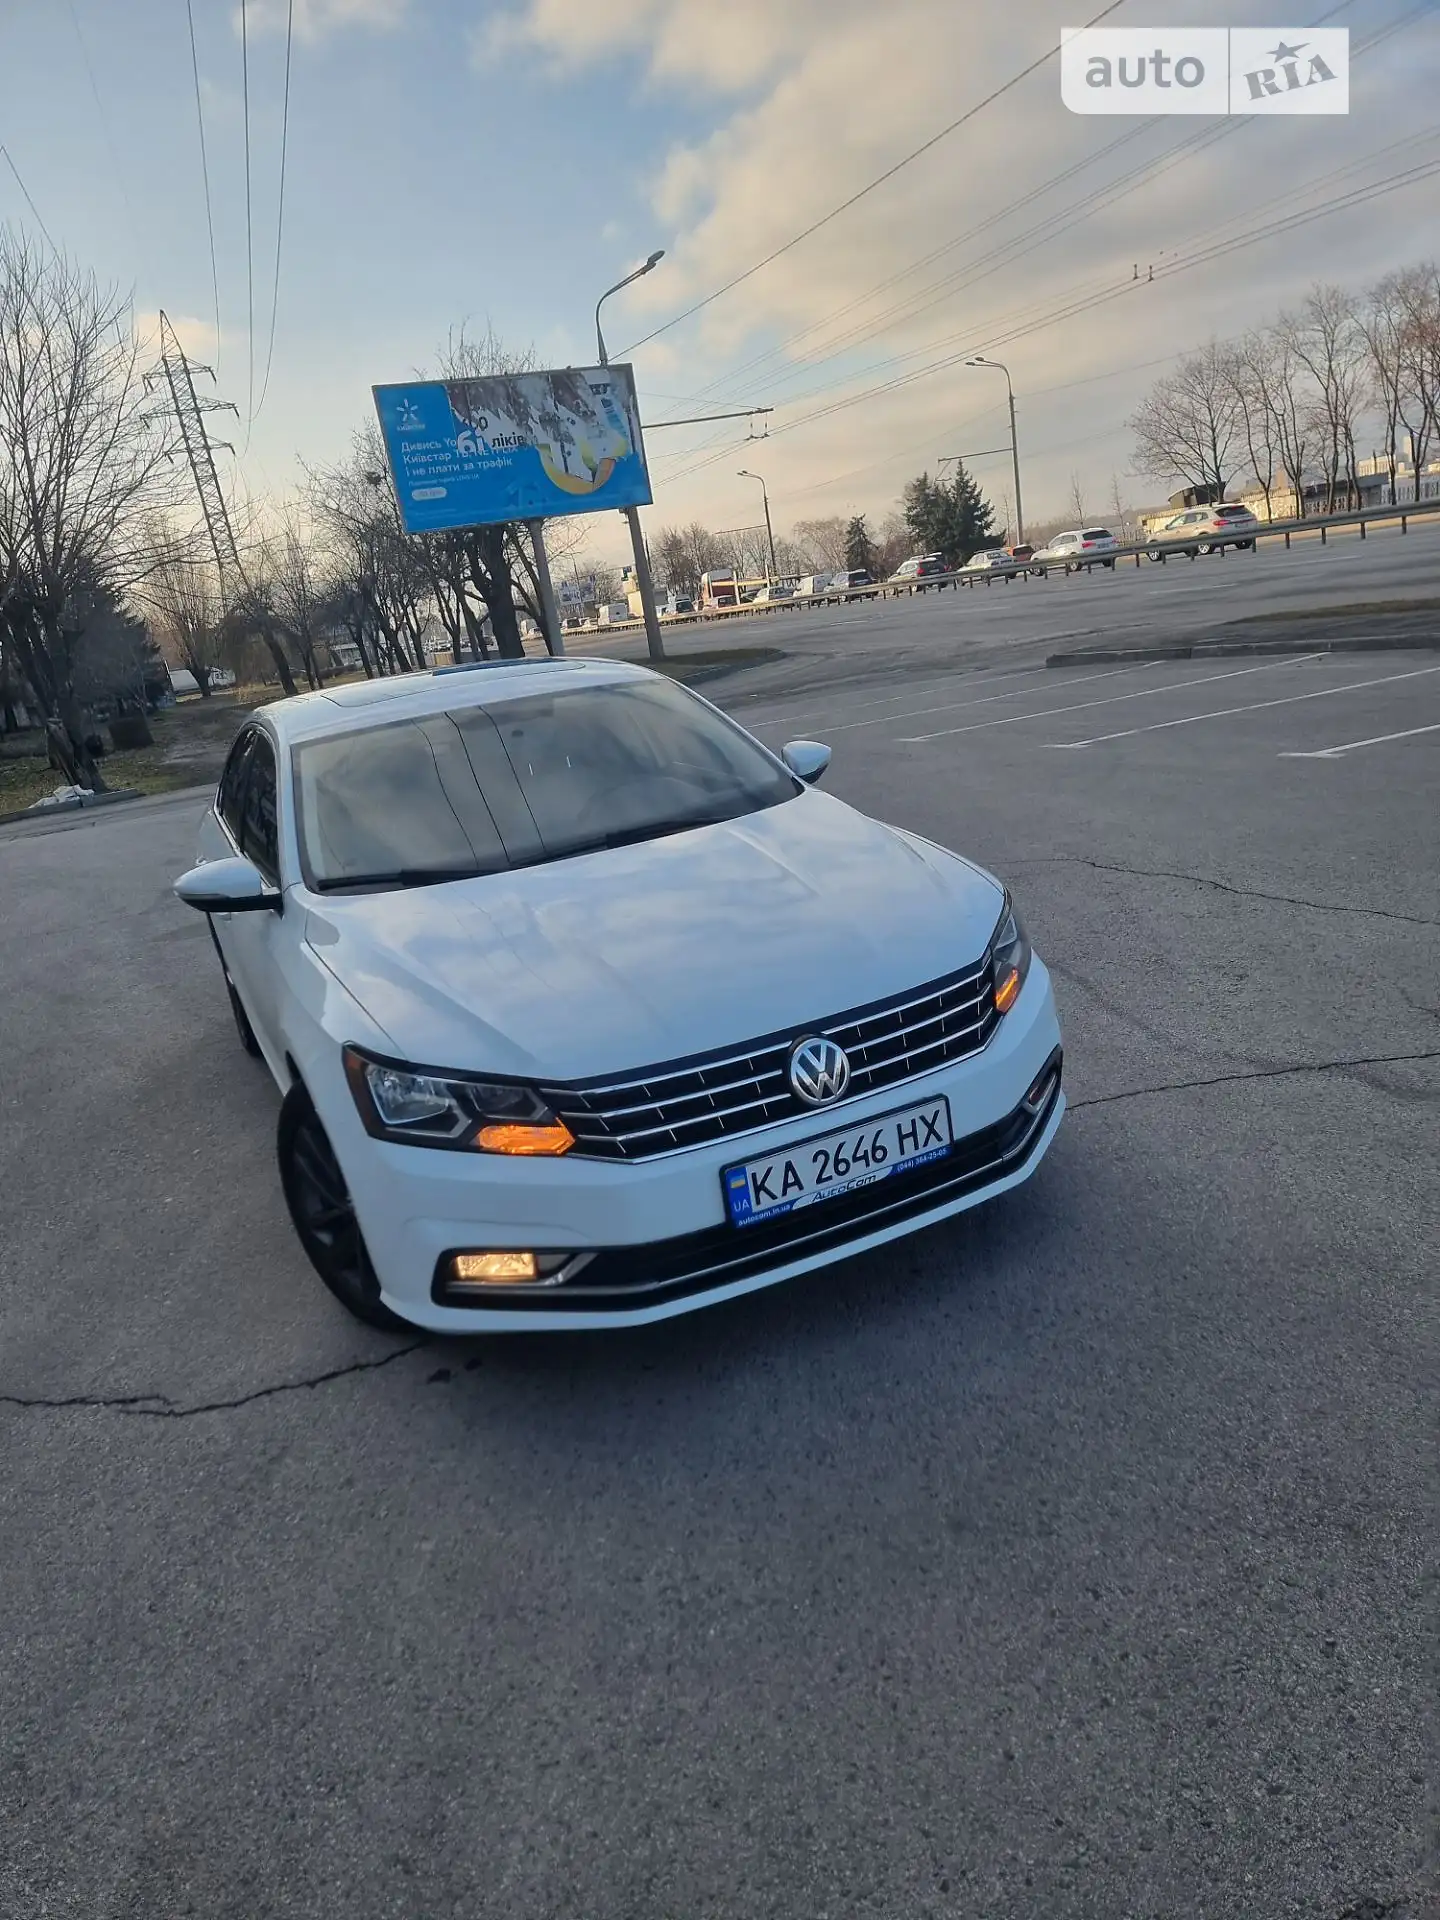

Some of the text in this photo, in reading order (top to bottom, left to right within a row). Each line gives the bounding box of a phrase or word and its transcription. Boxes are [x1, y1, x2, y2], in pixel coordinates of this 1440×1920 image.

[401, 440, 442, 454] Дивись
[403, 452, 452, 464] Київстар
[428, 463, 460, 475] плати
[463, 462, 474, 471] за
[478, 456, 513, 469] трафік
[750, 1109, 944, 1206] KA 2646 HX
[812, 1173, 877, 1203] AutoCom
[733, 1199, 750, 1212] UA
[738, 1204, 791, 1227] autocom.in.ua
